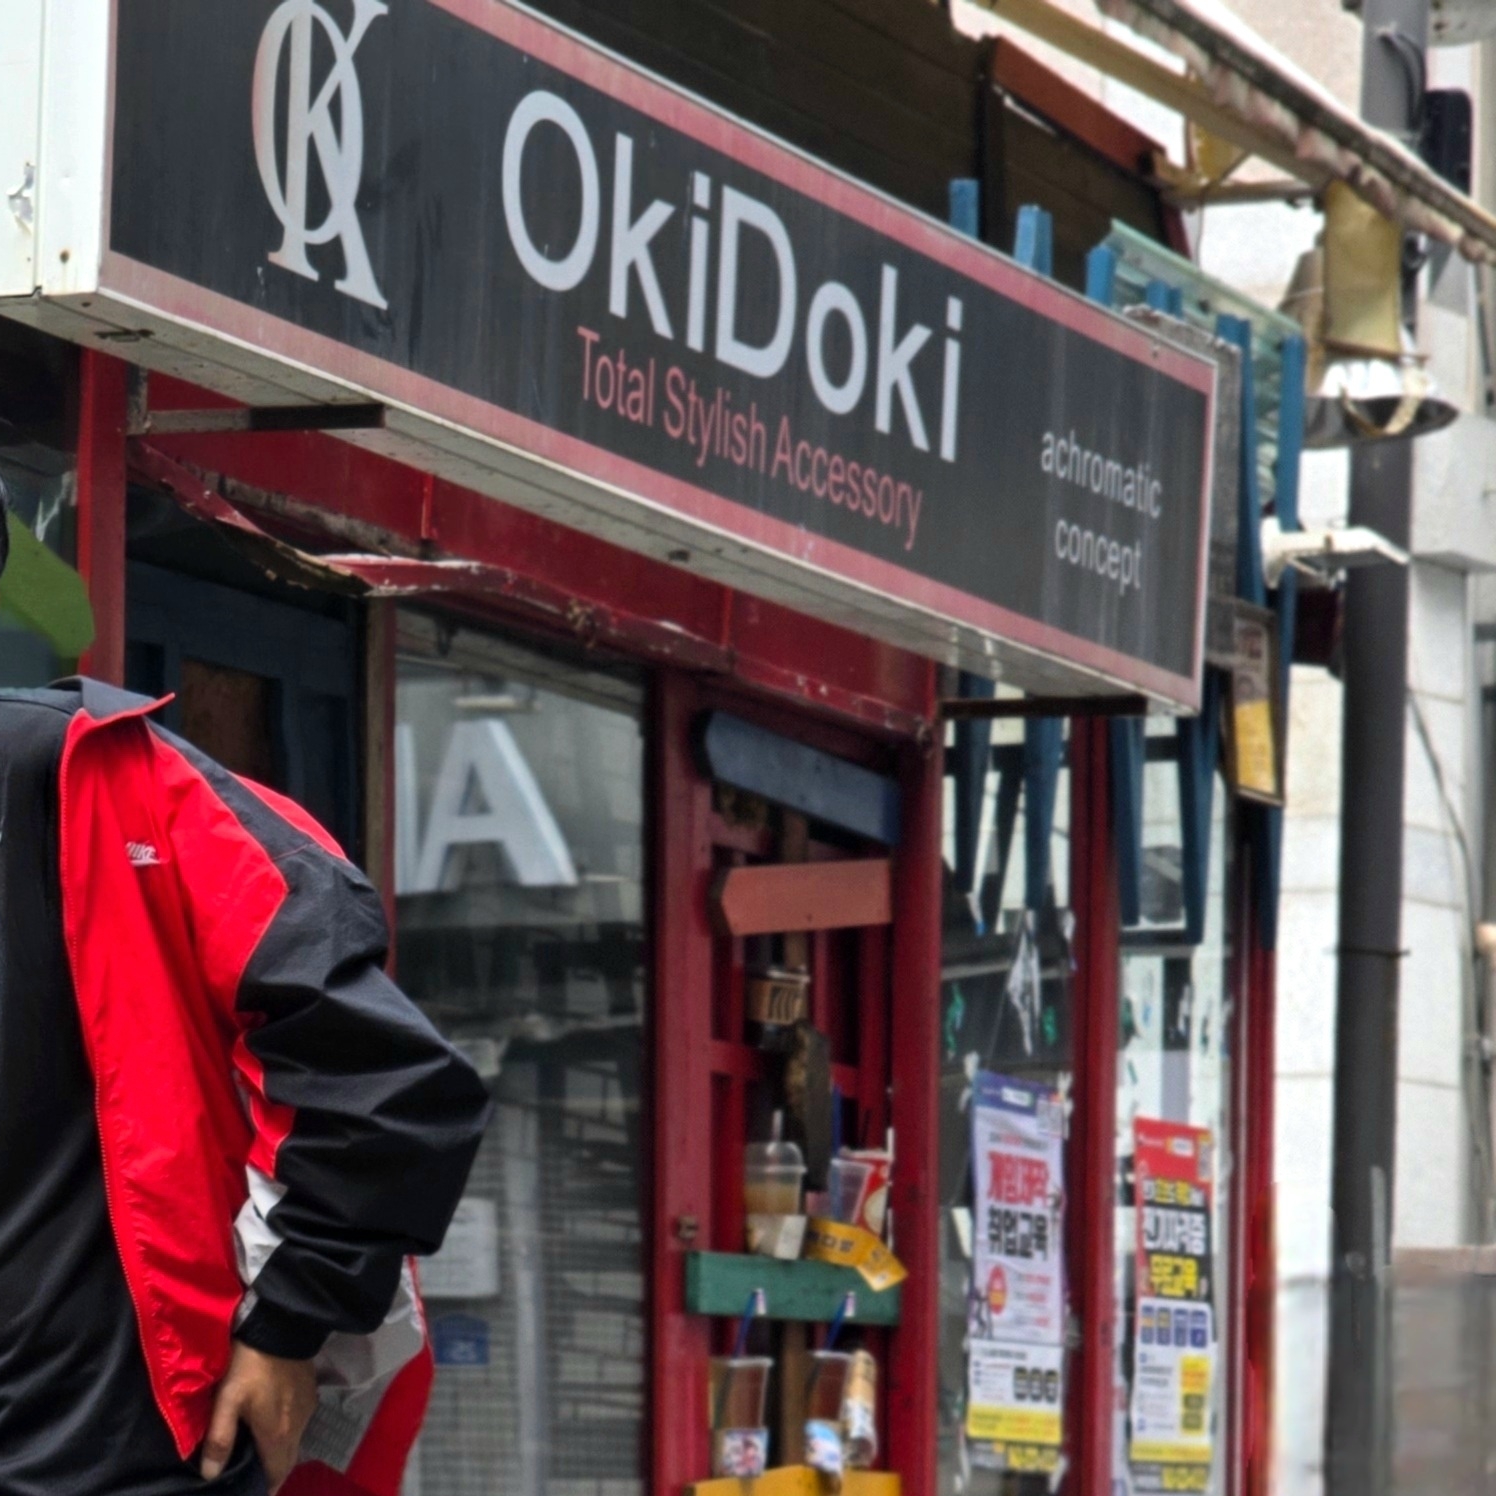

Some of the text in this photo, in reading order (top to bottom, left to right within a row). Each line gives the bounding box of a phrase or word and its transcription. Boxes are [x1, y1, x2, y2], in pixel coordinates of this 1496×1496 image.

[501, 89, 963, 463] OkiDoki
[577, 325, 924, 551] Total Stylish Accessory
[1040, 428, 1163, 520] achromatic
[1054, 517, 1143, 597] concept
